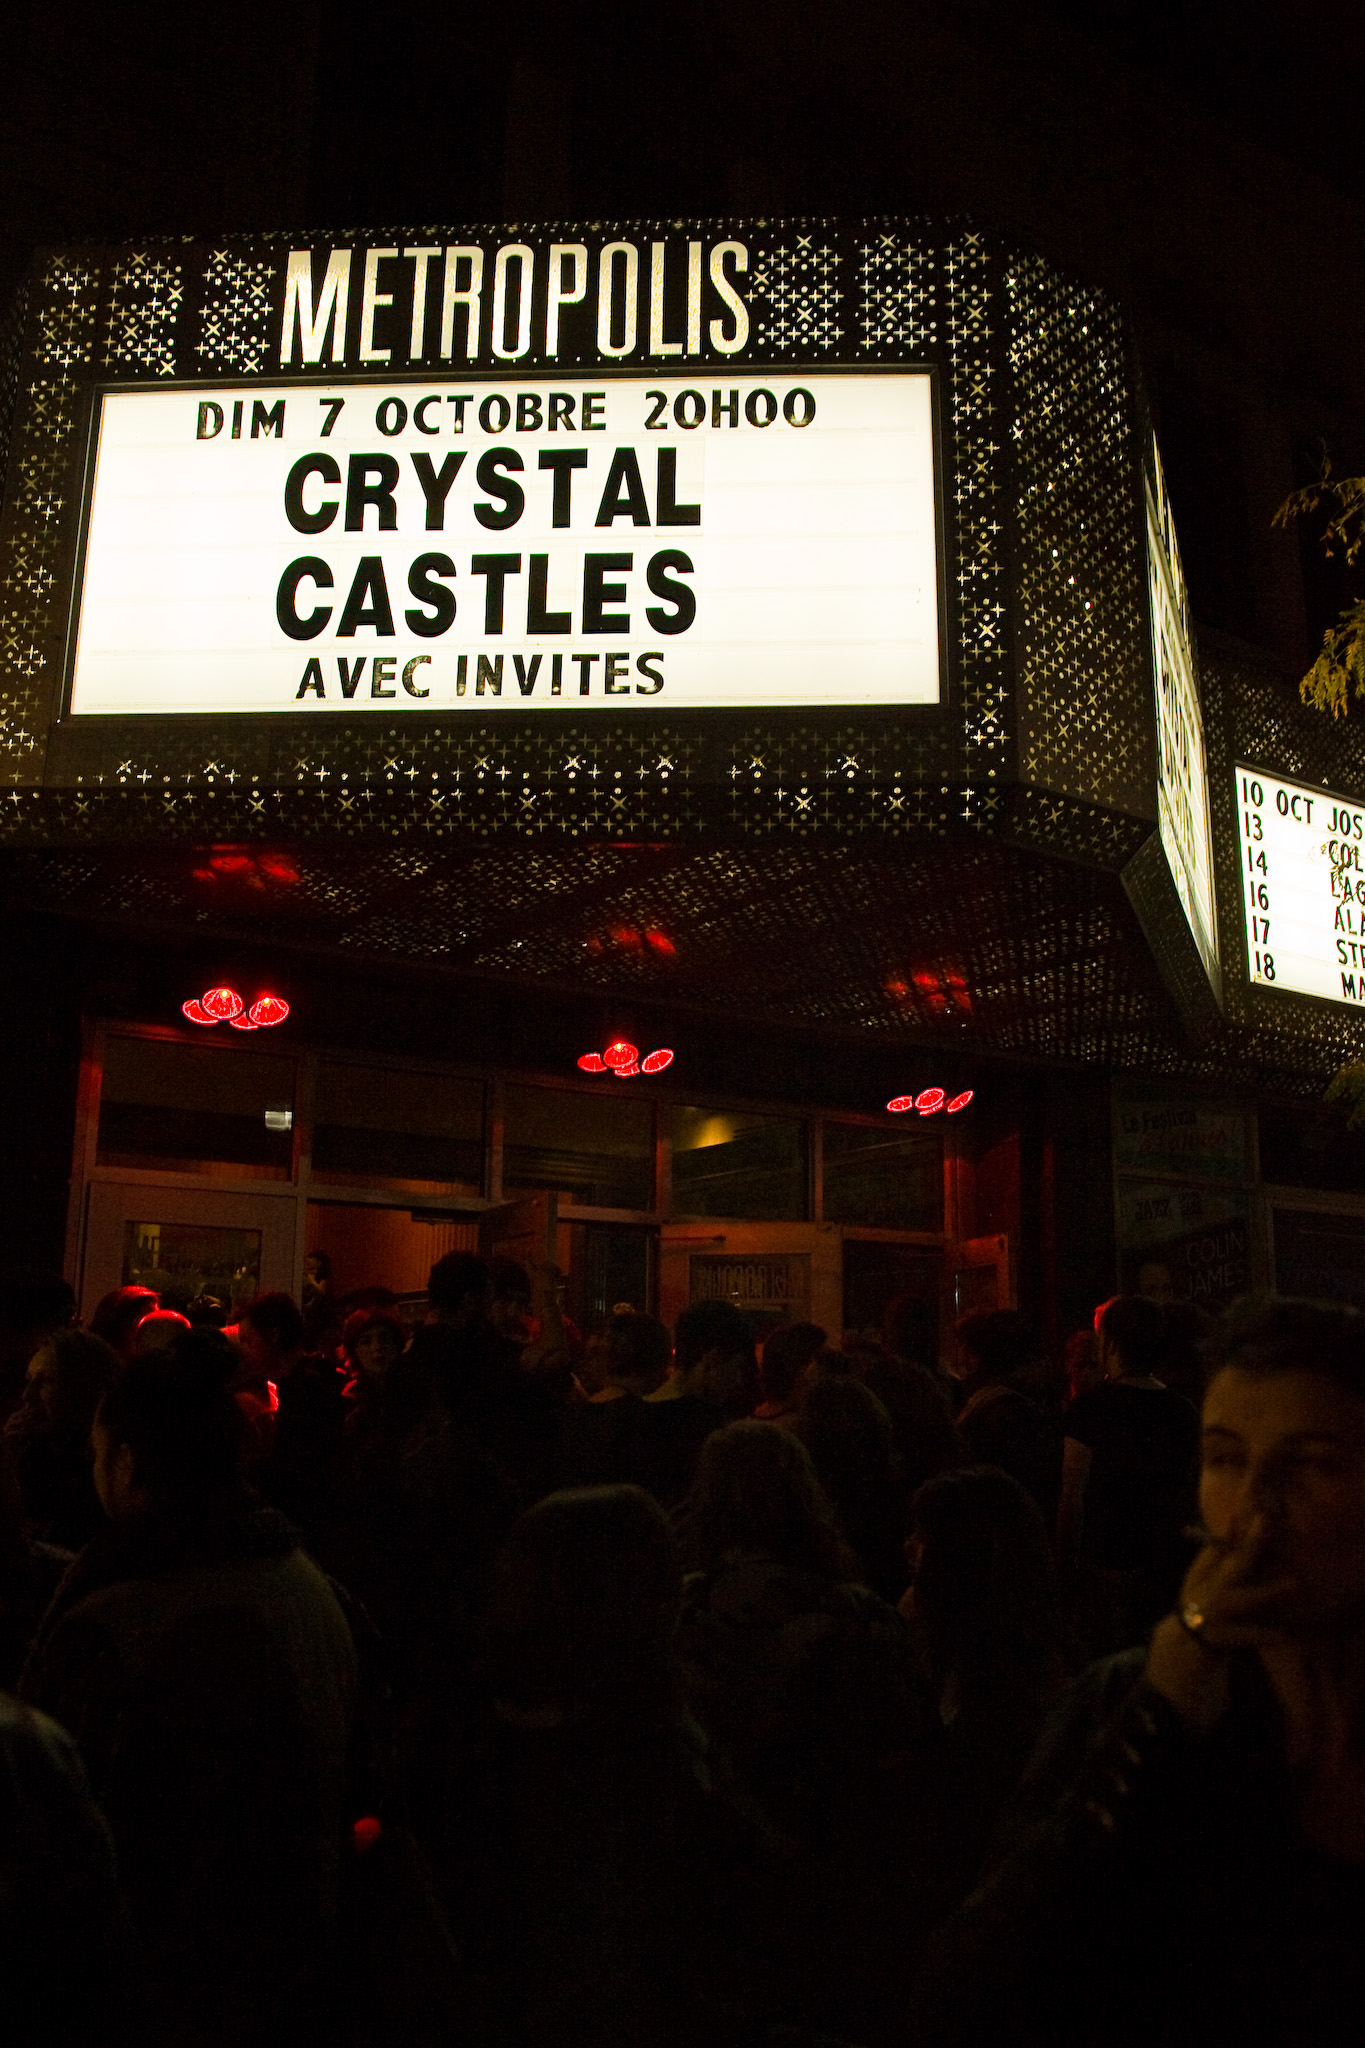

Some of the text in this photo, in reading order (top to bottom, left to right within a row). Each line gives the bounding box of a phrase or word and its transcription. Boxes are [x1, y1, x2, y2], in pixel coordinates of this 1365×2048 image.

[280, 240, 750, 364] METROPOLIS
[196, 400, 286, 440] DIM
[319, 398, 346, 437] 7
[375, 391, 607, 437] OCTOBRE
[284, 446, 701, 535] CRYSTAL
[276, 548, 697, 641] CASTLES
[295, 652, 664, 699] AVEC INVITES
[1243, 777, 1363, 840] 10 OCT JOS
[1245, 812, 1364, 873] 13 COL
[1248, 846, 1268, 877] 14
[1250, 881, 1269, 911] 16
[1252, 915, 1270, 945] 17
[1255, 951, 1276, 981] 18
[1185, 1230, 1245, 1267] COLIN
